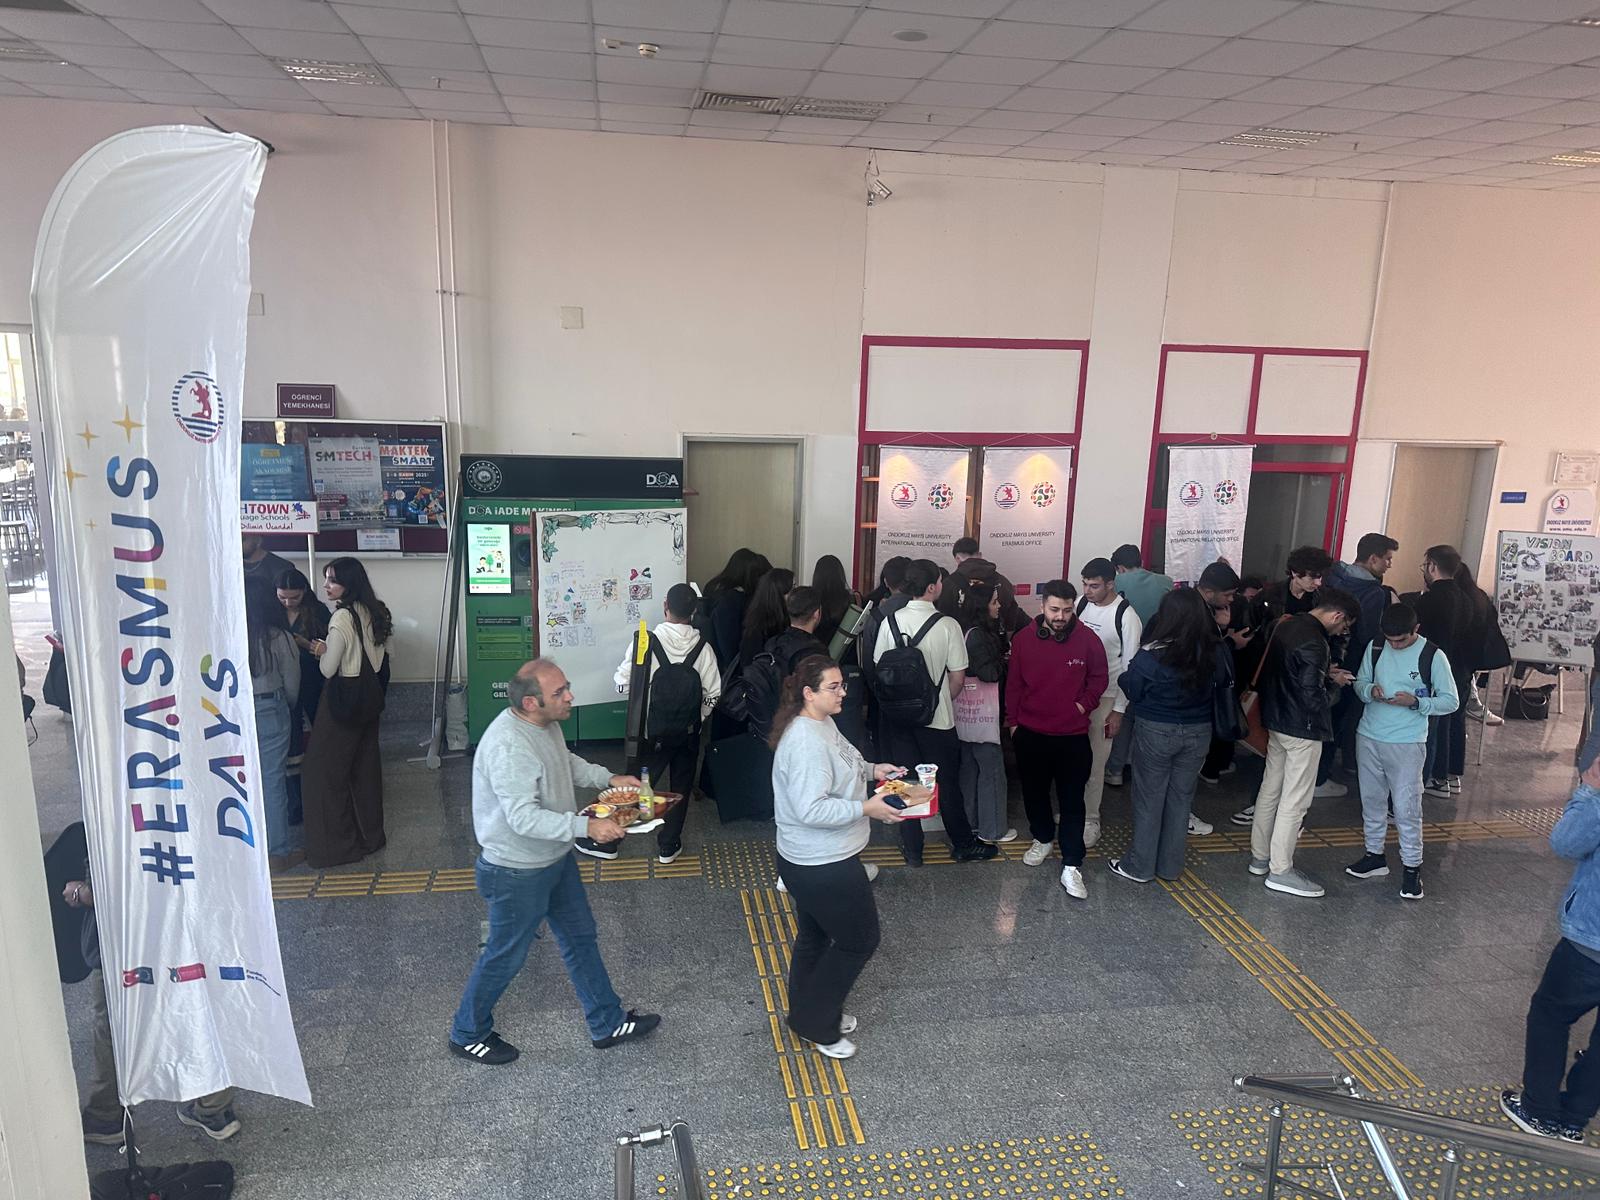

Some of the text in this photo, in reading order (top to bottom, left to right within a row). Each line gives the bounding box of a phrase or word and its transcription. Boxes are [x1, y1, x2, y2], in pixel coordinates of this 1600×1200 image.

[316, 450, 372, 462] SMTECH
[380, 446, 428, 456] MAKTEK
[393, 456, 434, 465] SMART
[240, 504, 289, 514] HTOWN
[1526, 537, 1573, 550] VISION
[1550, 550, 1593, 562] BOARD
[107, 454, 196, 886] #ERASMUS
[200, 652, 256, 850] DAYS
